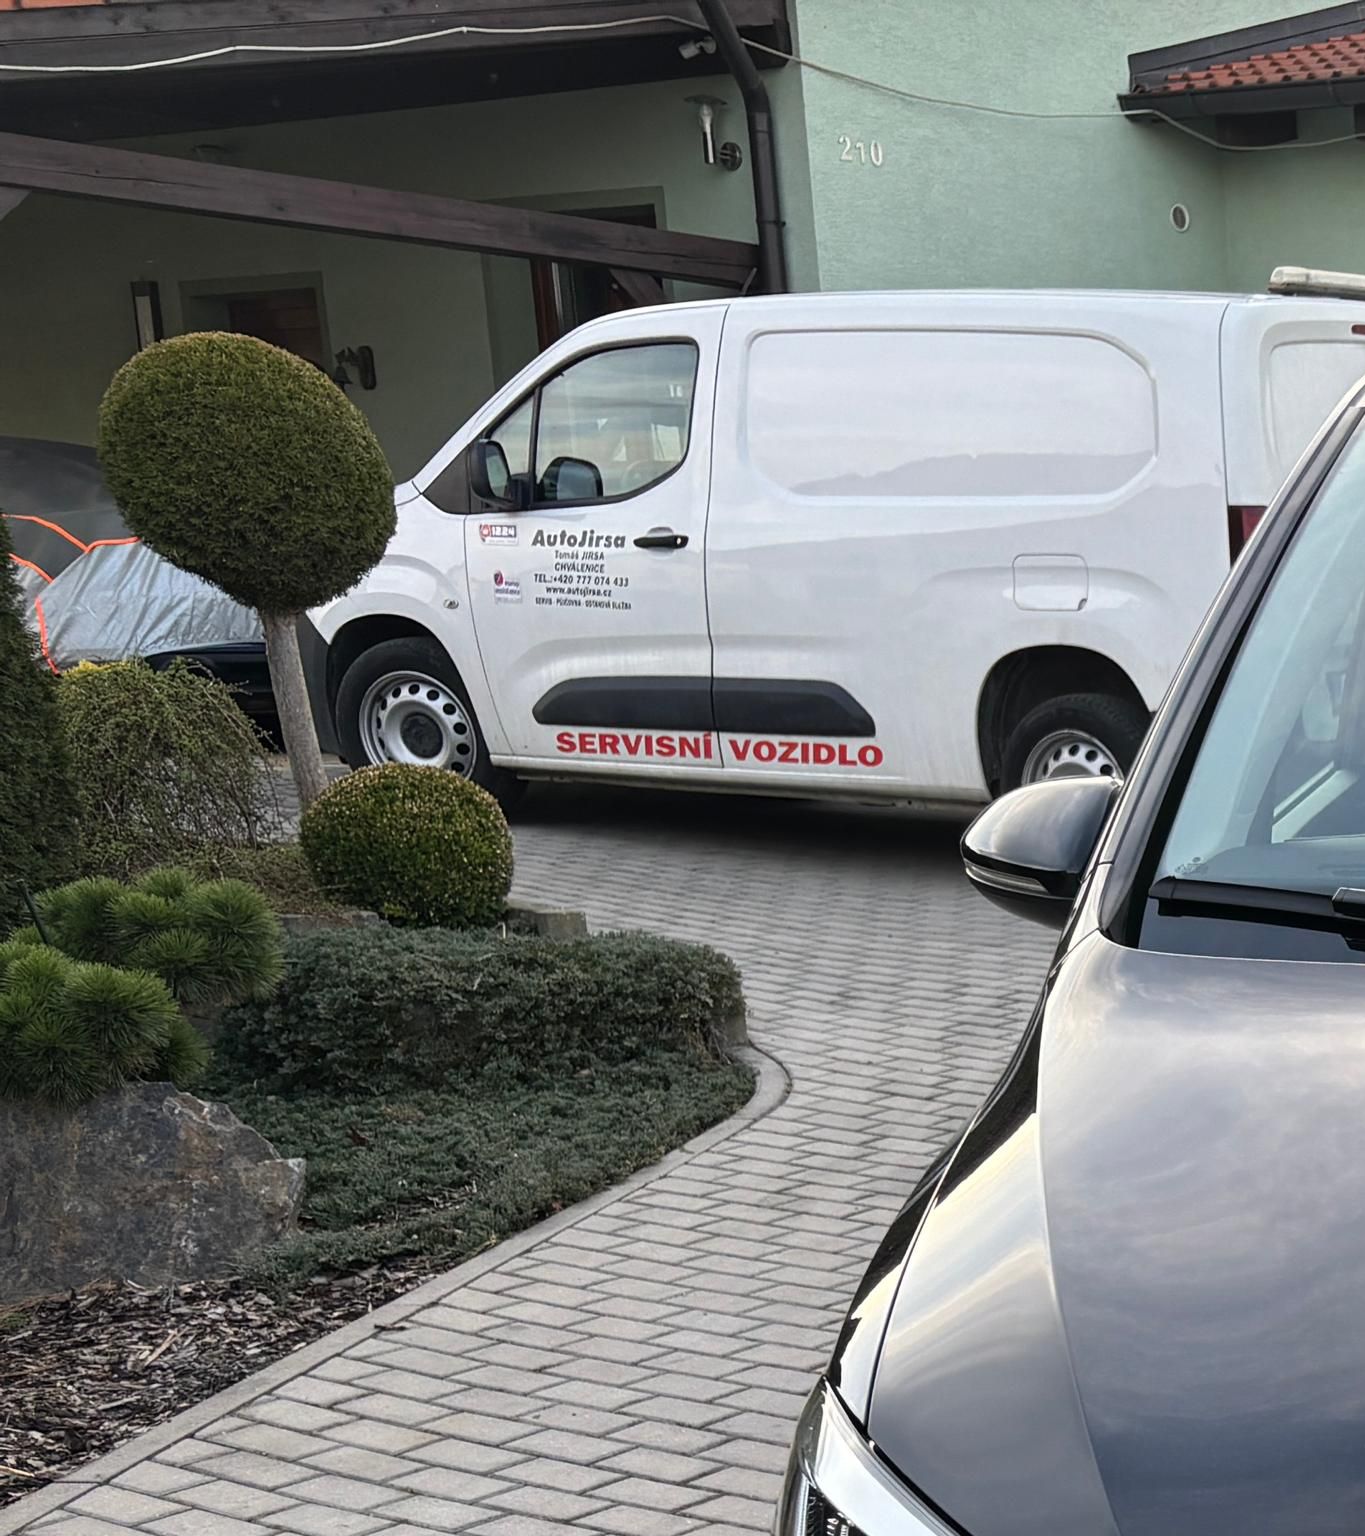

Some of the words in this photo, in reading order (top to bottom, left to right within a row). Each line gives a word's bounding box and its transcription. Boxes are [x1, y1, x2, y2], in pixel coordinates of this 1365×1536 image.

[838, 134, 883, 168] 210
[532, 529, 626, 548] AutoJirsa
[581, 551, 605, 561] JIRSA
[576, 575, 592, 585] 777
[594, 575, 611, 586] 074
[613, 576, 630, 588] 433
[546, 586, 612, 598] www.autojirsa.cz
[556, 730, 714, 761] SERVISNÍ
[727, 738, 884, 768] VOZIDLO
